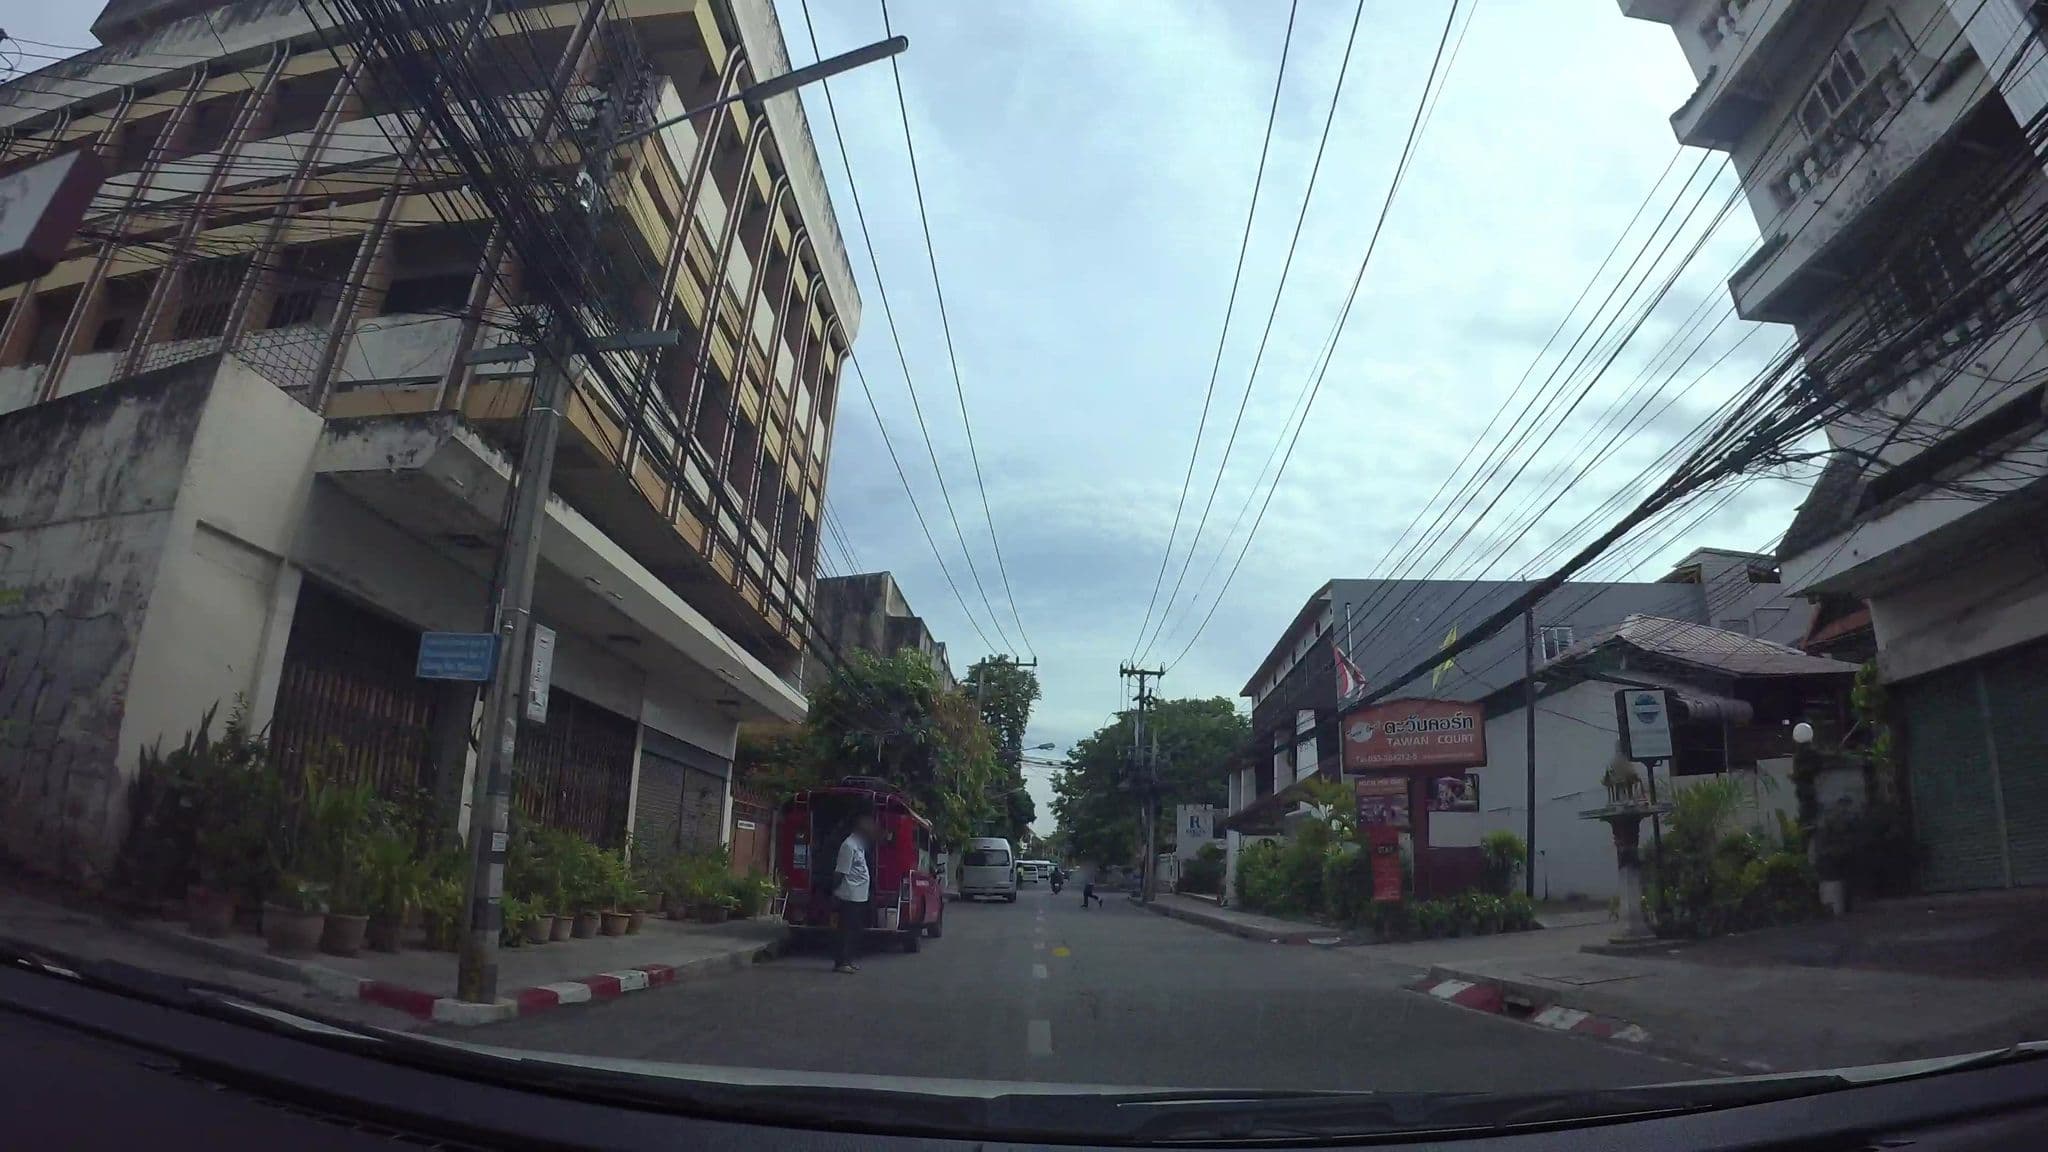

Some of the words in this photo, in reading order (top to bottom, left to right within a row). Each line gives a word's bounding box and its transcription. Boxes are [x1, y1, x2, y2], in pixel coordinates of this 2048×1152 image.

[1384, 711, 1474, 734] ตะวันคอร์ท
[1386, 736, 1429, 747] TAWAN
[1437, 734, 1474, 745] COURT
